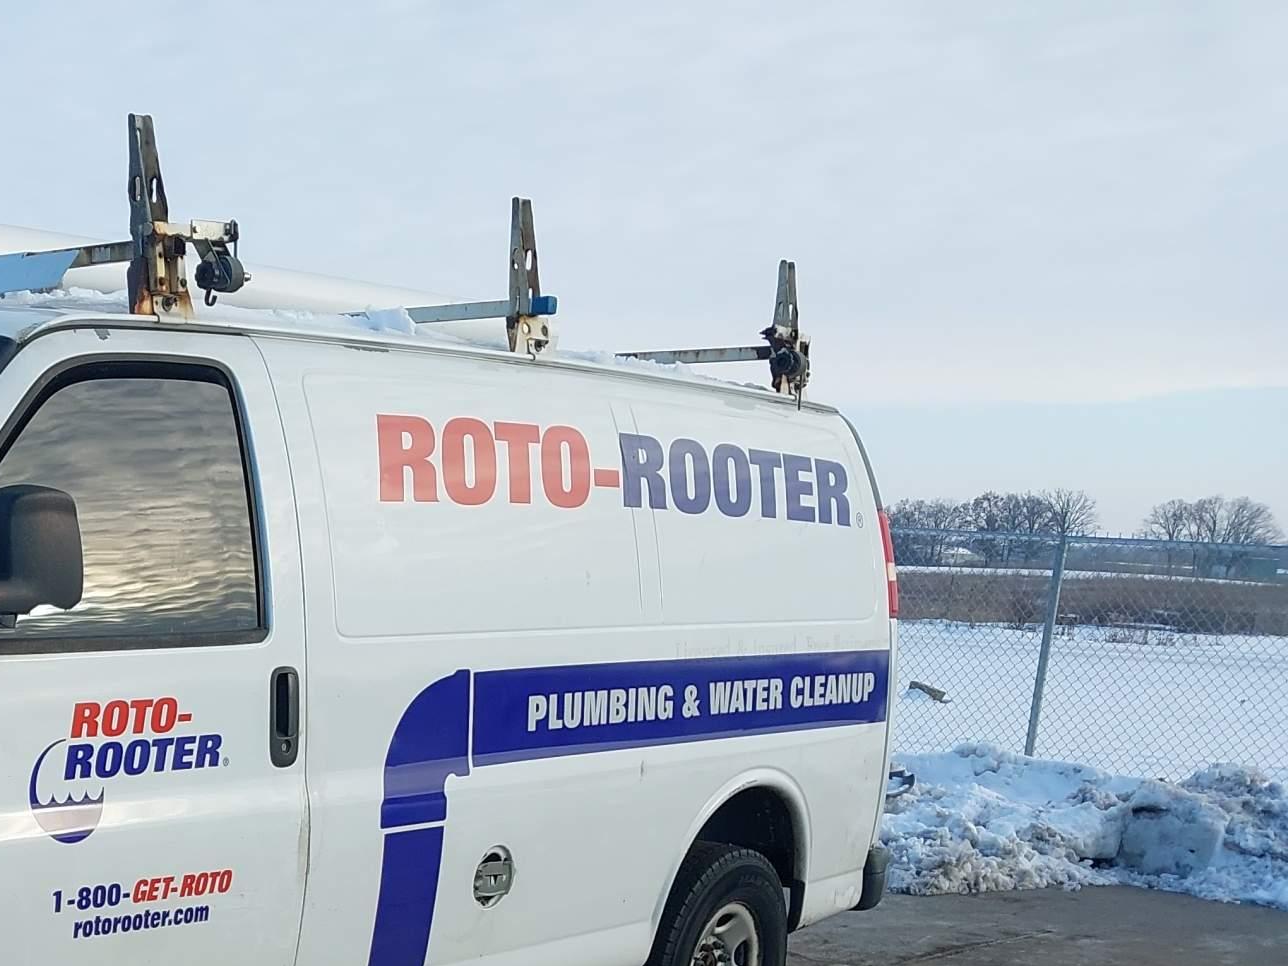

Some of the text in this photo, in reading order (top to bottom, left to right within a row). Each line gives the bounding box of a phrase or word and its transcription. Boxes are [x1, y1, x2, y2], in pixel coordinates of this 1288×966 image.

[70, 697, 192, 738] ROTO-
[527, 672, 876, 732] PLUMBING & WATER CLEANUP
[63, 733, 223, 781] ROOTER
[52, 868, 234, 913] 1-800-GET-ROTO
[72, 904, 210, 939] rotorooter.com
